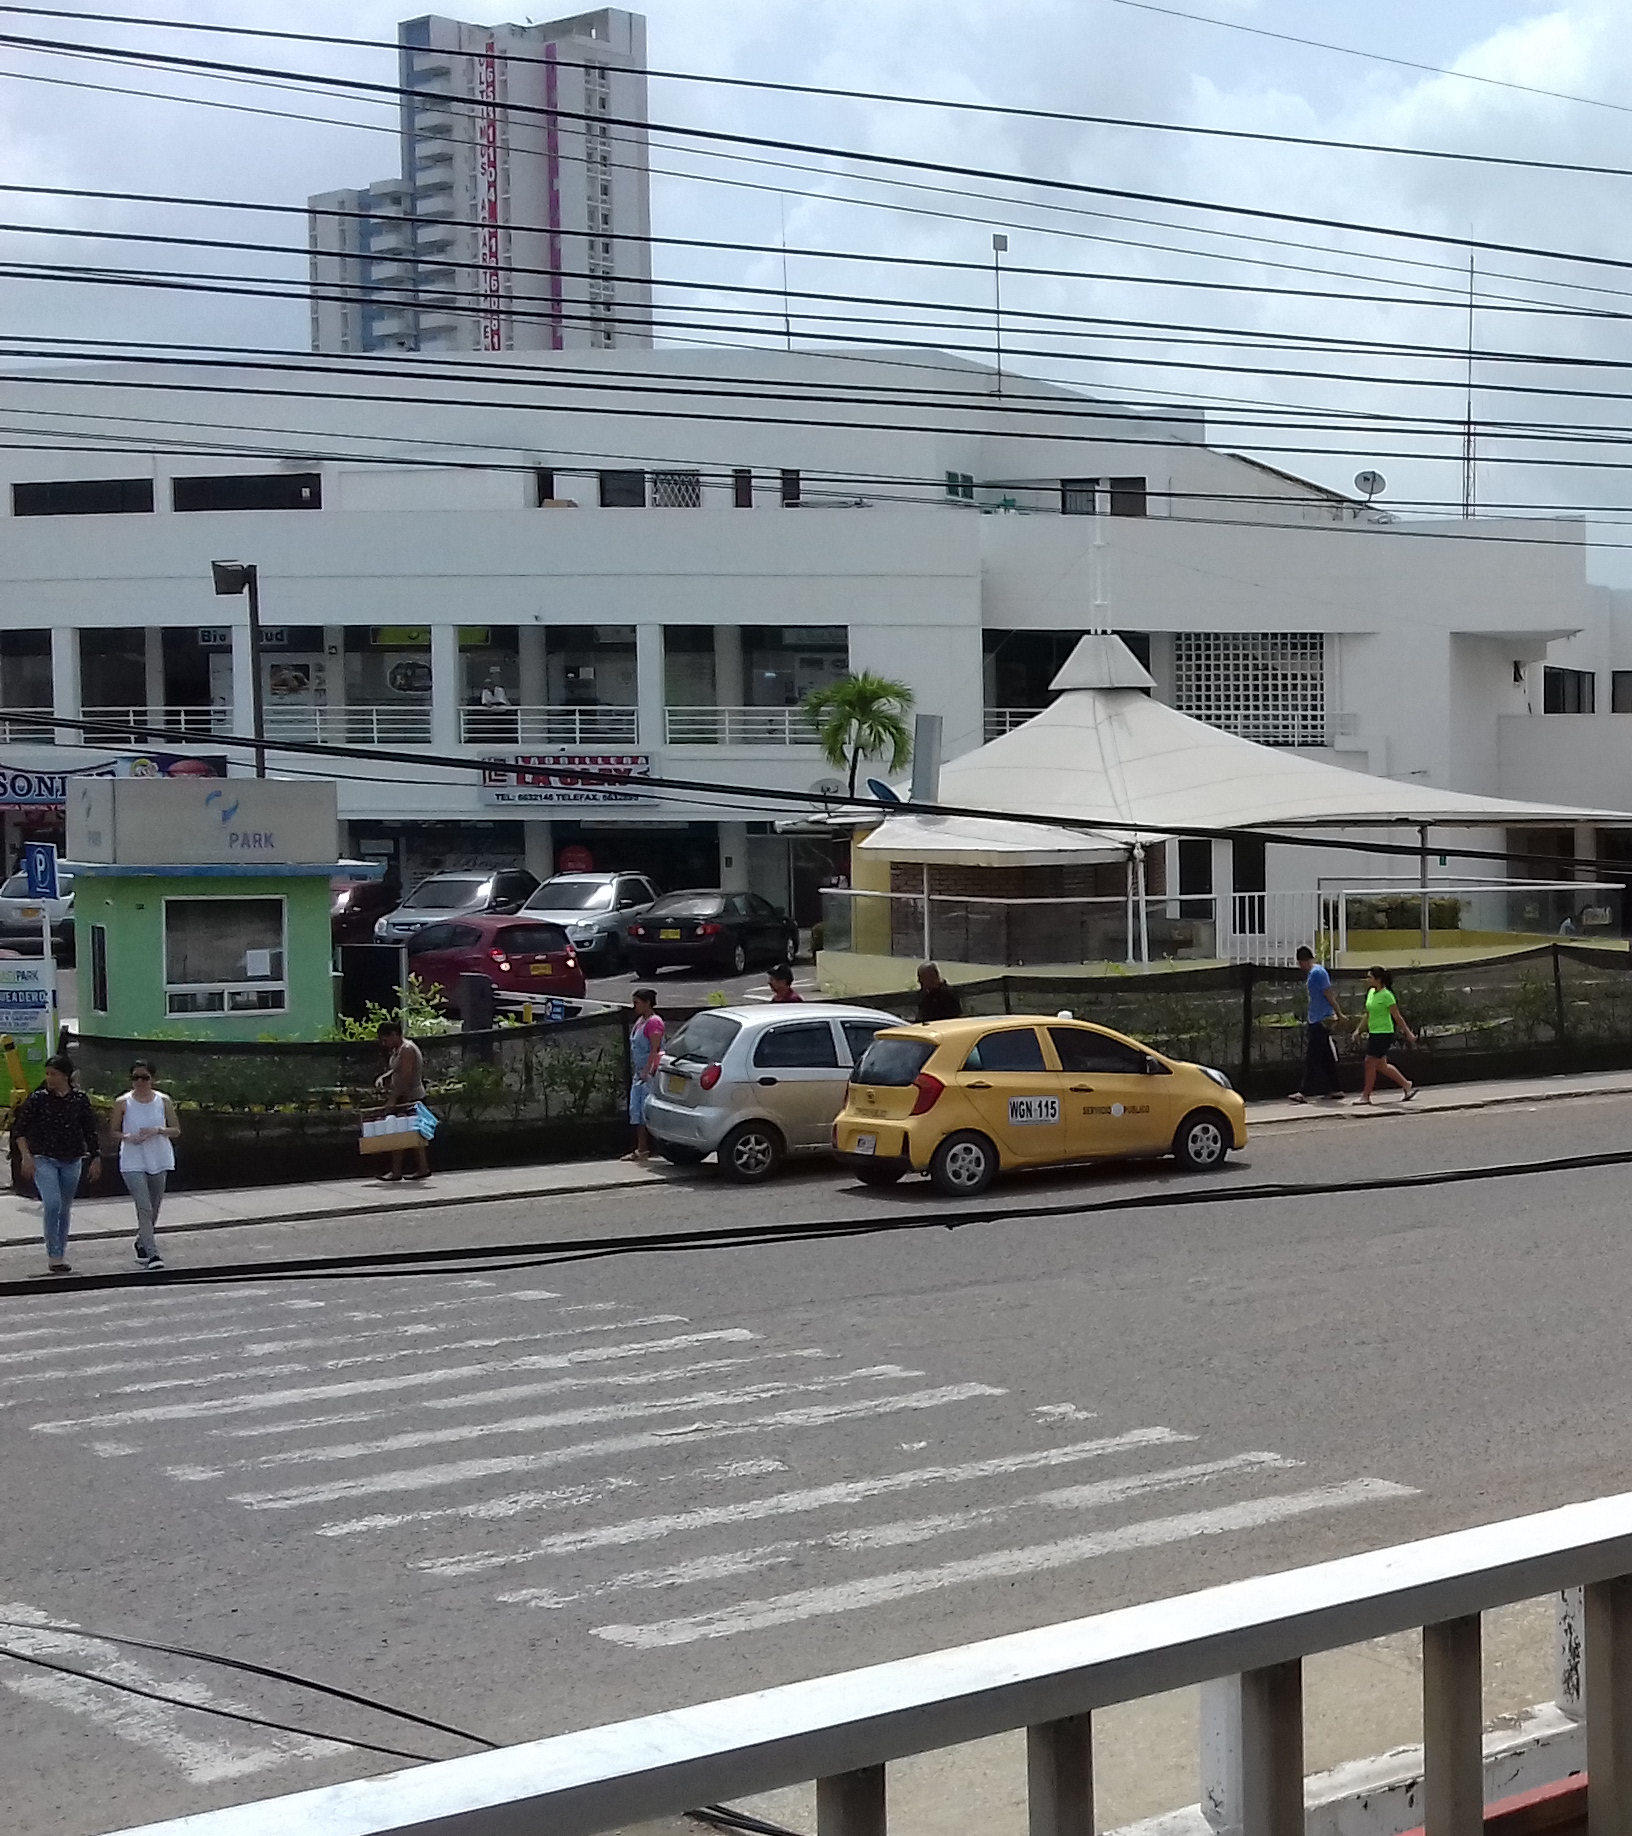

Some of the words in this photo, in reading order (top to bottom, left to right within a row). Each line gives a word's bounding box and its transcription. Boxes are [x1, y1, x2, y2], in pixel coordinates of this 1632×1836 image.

[229, 832, 275, 849] PARK
[1009, 1100, 1033, 1119] WGN
[1037, 1100, 1057, 1118] 115
